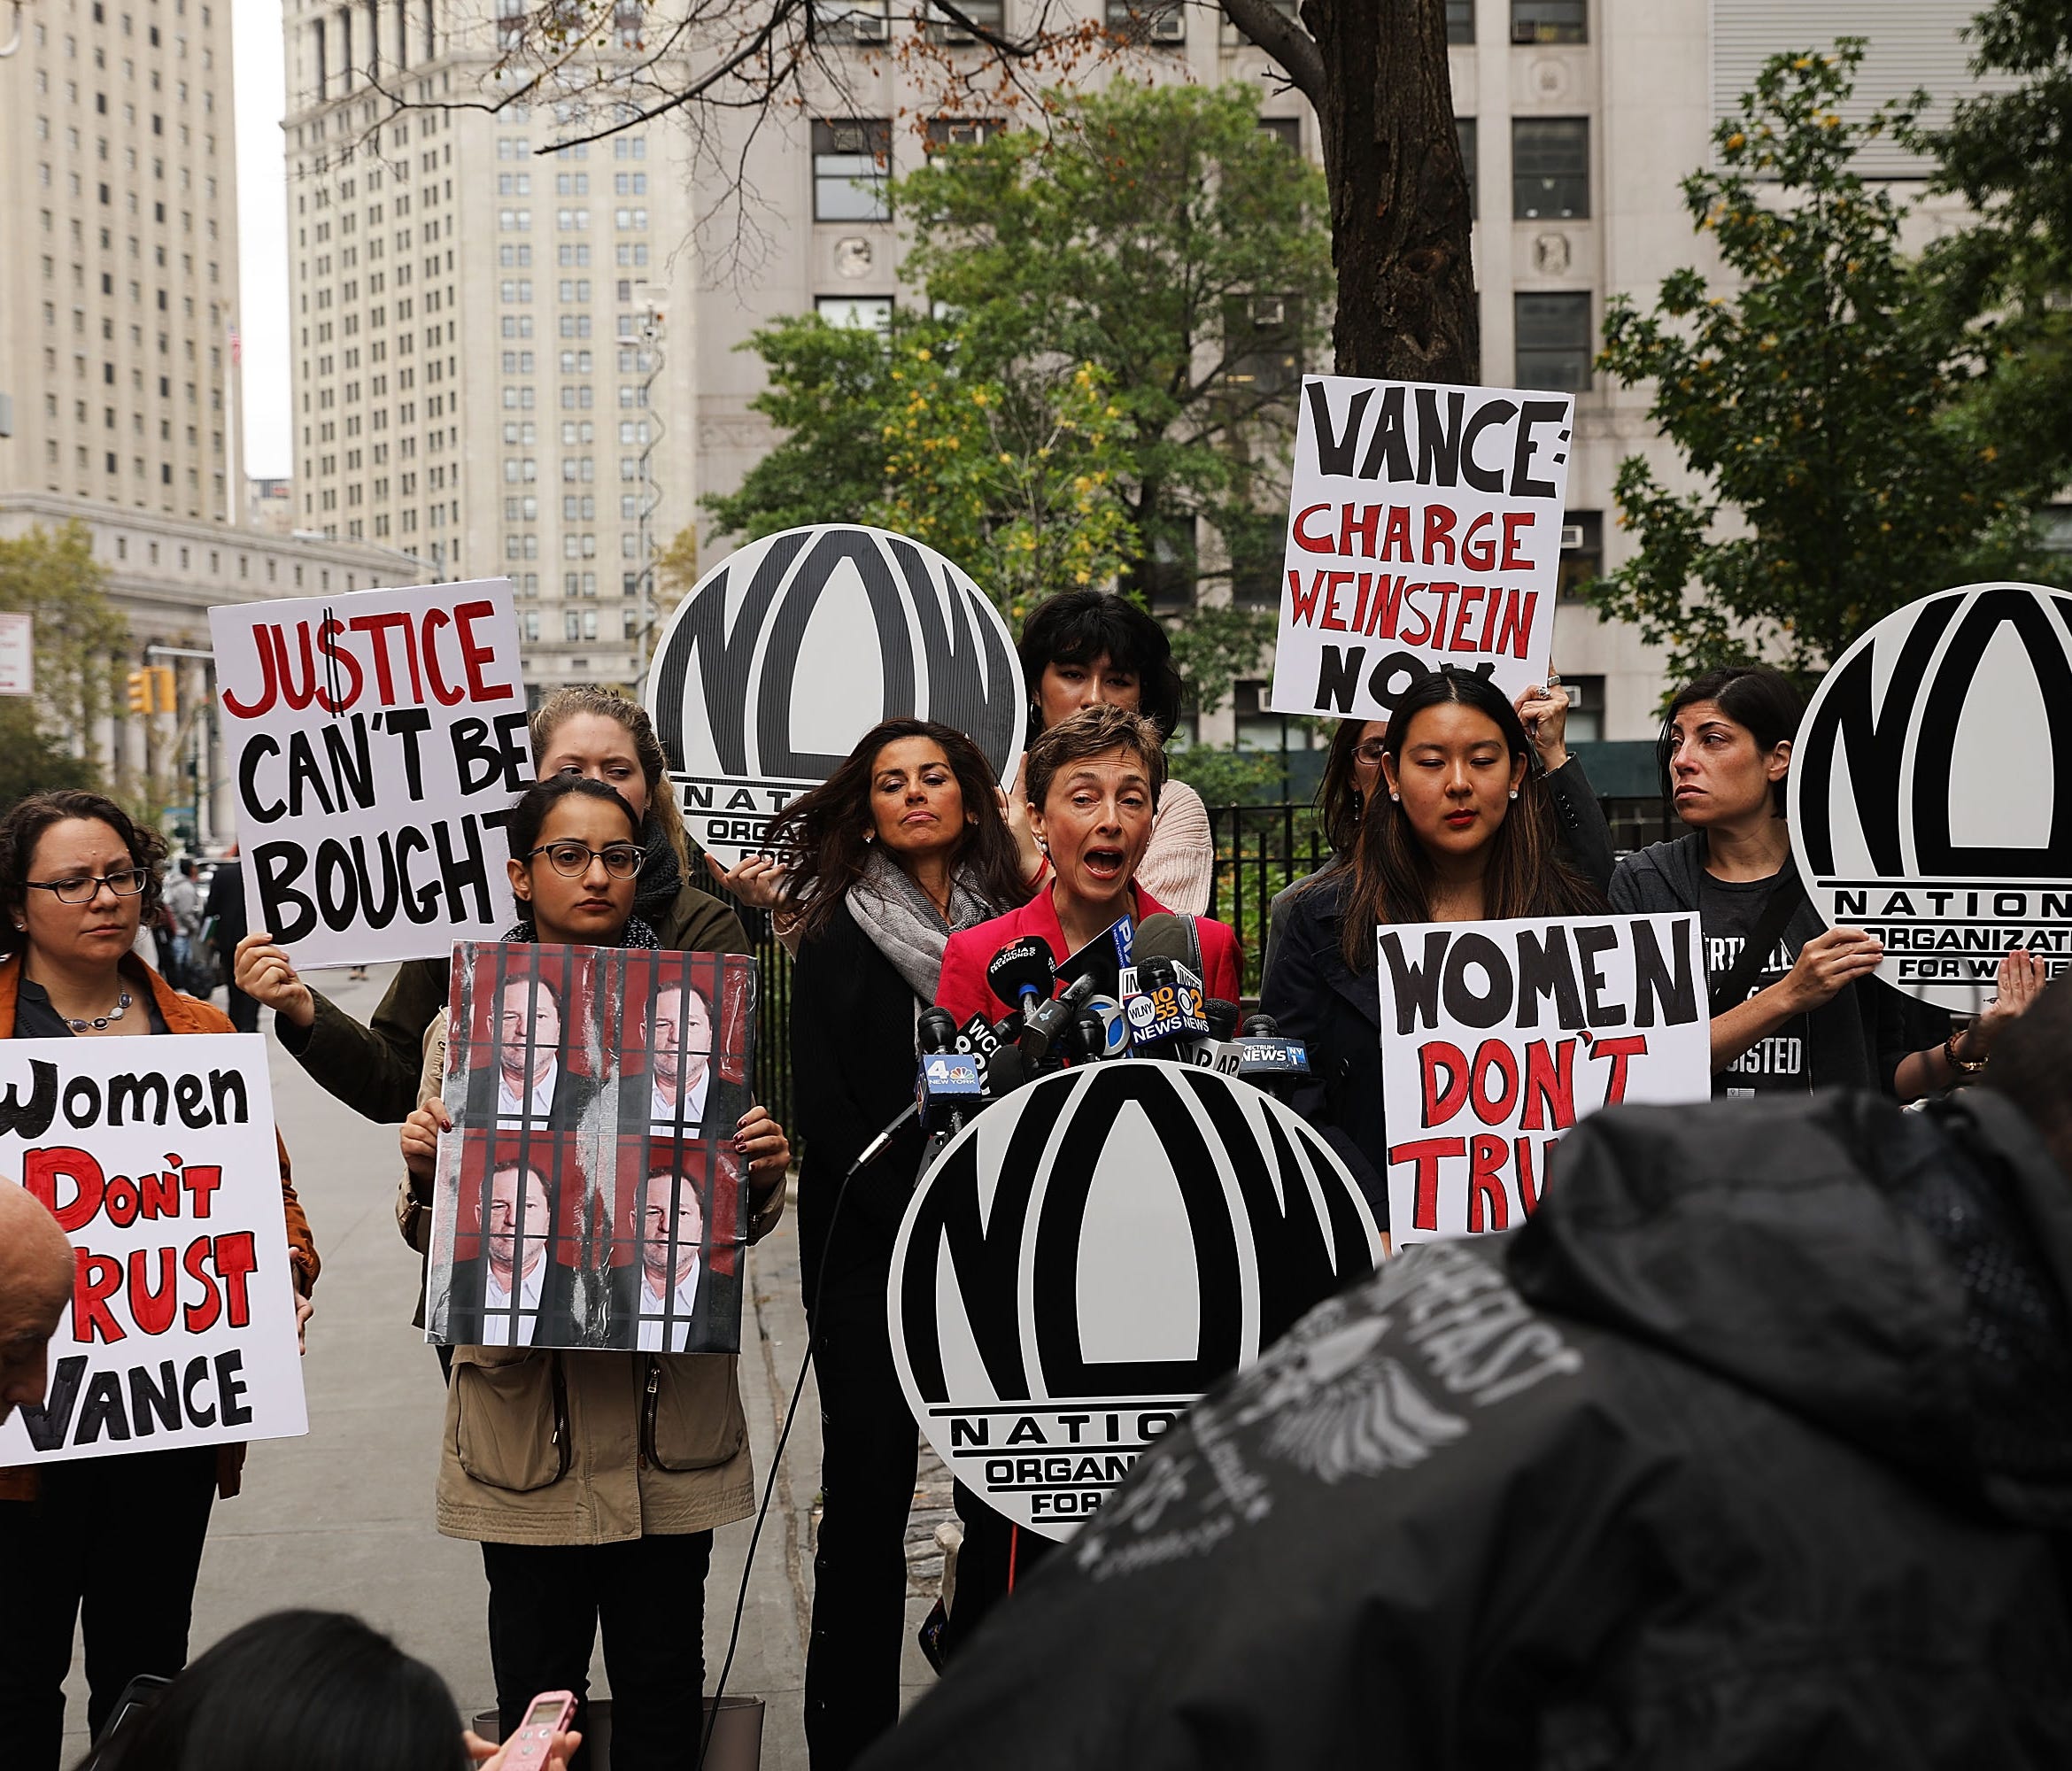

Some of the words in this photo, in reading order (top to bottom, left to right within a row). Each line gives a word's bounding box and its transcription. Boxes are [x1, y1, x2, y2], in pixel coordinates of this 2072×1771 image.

[1305, 382, 1571, 498] VANCE:
[1293, 503, 1535, 571] CHARGE
[1288, 569, 1538, 660] WEINSTEIN
[1314, 646, 1496, 713] NO
[1799, 588, 2072, 878] NO
[238, 708, 430, 824] CAN'T
[450, 711, 537, 796] BE
[1835, 891, 2072, 917] NATION
[1863, 928, 2072, 950] ORGANIZAT
[1380, 919, 1698, 1034] WOMEN
[1899, 960, 1960, 978] FOR
[1129, 1002, 1152, 1020] WLNY
[1151, 986, 1173, 1005] 10
[1156, 1001, 1179, 1021] 55
[1190, 988, 1206, 1019] 2
[969, 1018, 1002, 1058] WC
[1133, 1016, 1182, 1044] NEWS
[1182, 1016, 1210, 1032] NEWS
[927, 1060, 949, 1079] 4
[1241, 1050, 1286, 1062] NEWS
[1418, 1031, 1648, 1130] DON'T
[73, 1232, 258, 1345] RUST
[19, 1349, 253, 1452] VANCE
